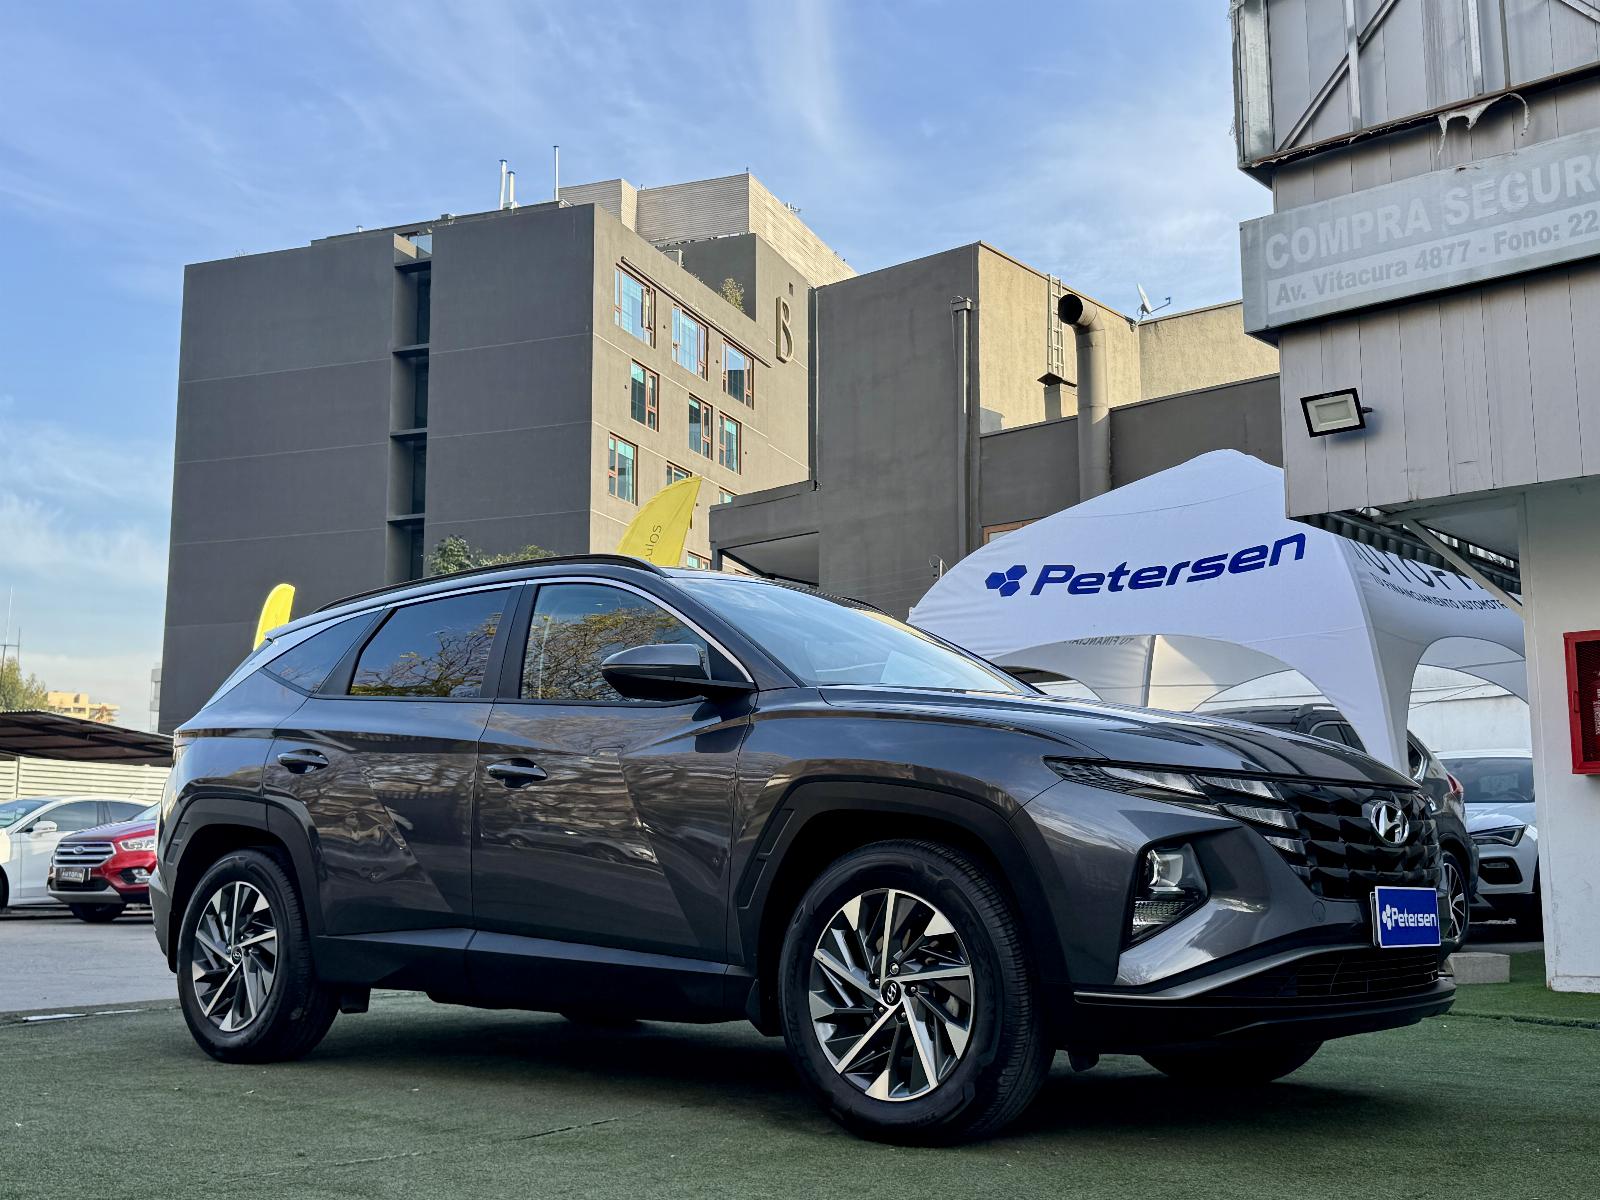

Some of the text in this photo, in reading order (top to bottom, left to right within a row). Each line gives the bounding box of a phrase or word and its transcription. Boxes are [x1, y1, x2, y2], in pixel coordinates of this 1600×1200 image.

[1265, 198, 1432, 270] COMPRA
[1276, 283, 1307, 306] Av.
[1313, 260, 1408, 295] Vitacura
[1414, 240, 1471, 271] 4877
[1493, 224, 1560, 255] Fono:
[1568, 209, 1599, 237] 22
[1029, 532, 1307, 596] Petersen
[1391, 907, 1437, 928] Petersen
